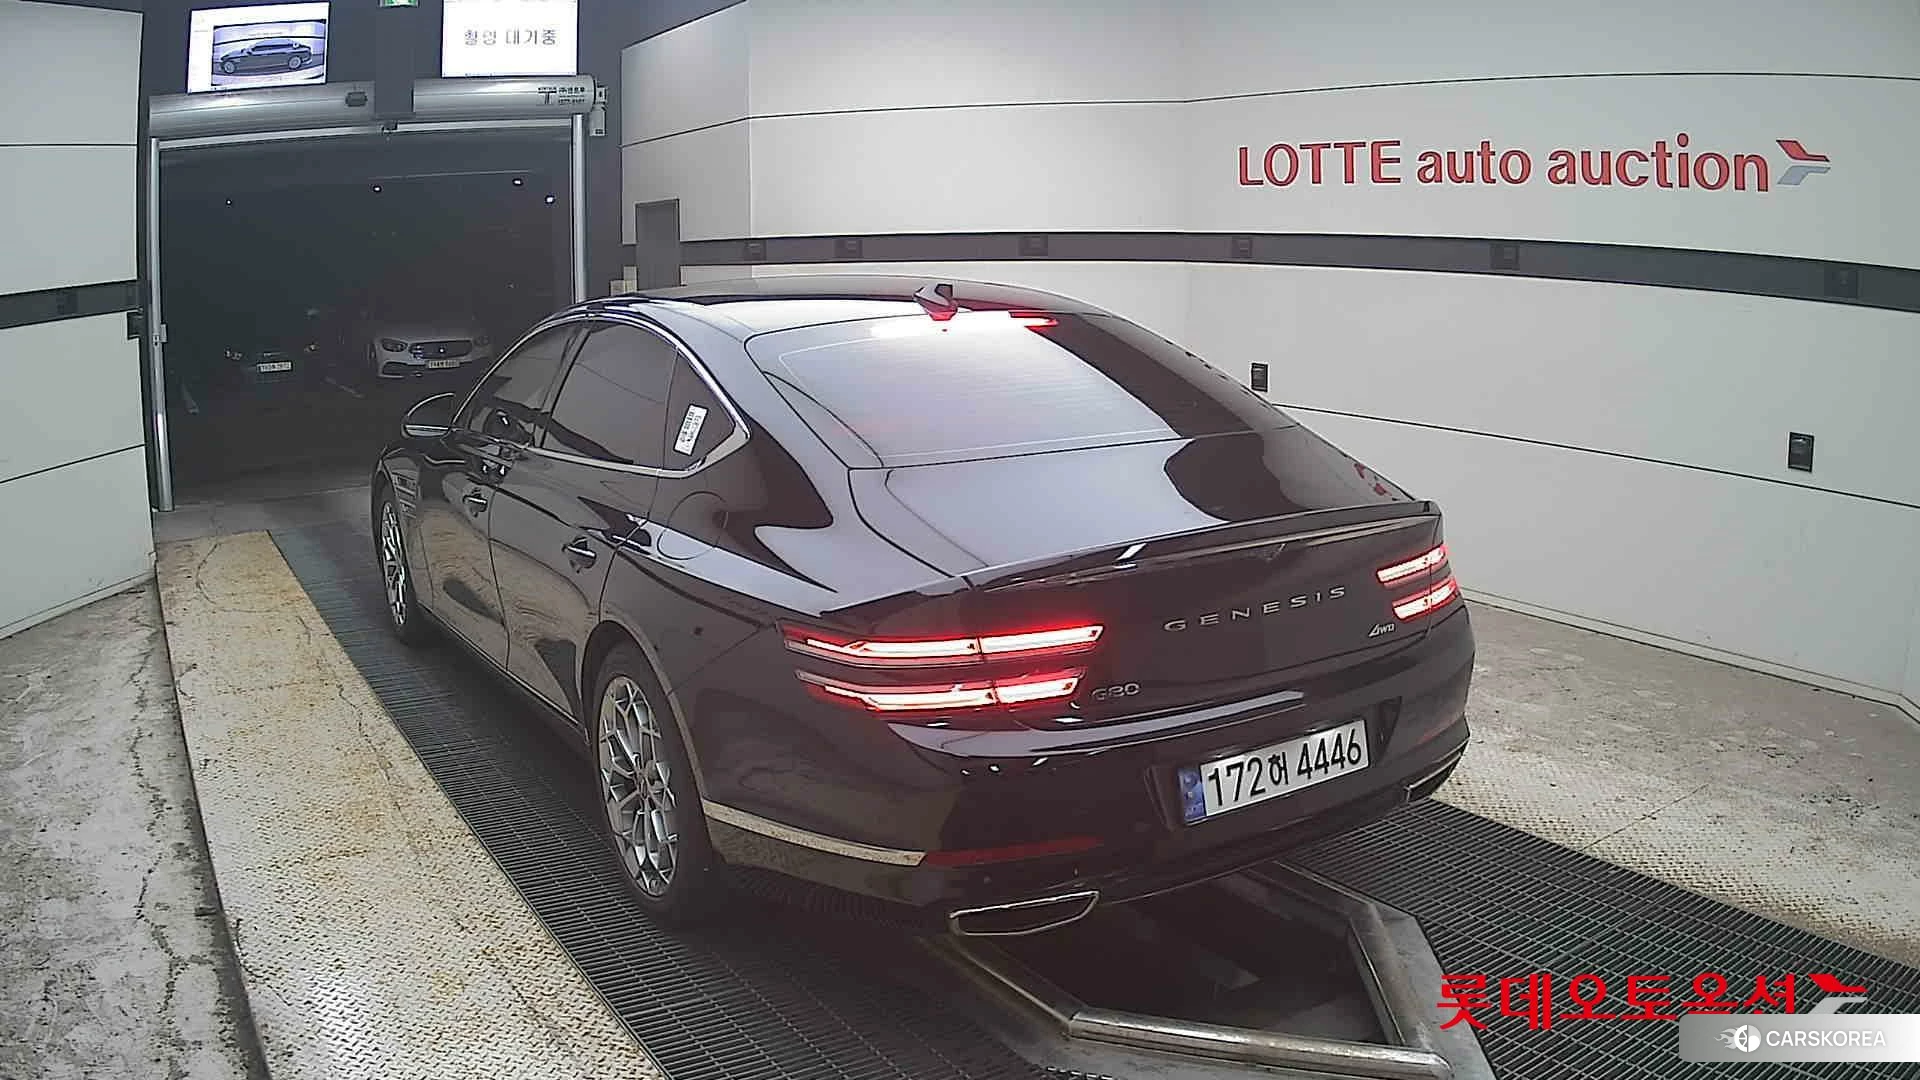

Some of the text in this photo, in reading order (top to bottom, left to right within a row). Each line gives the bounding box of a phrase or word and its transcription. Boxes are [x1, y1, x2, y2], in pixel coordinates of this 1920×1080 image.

[505, 28, 557, 46] 대기중
[1239, 132, 1769, 193] LOTTE auto auction
[1164, 586, 1346, 632] GENESIS
[1091, 683, 1140, 701] G80
[1207, 727, 1363, 807] 172허 4446
